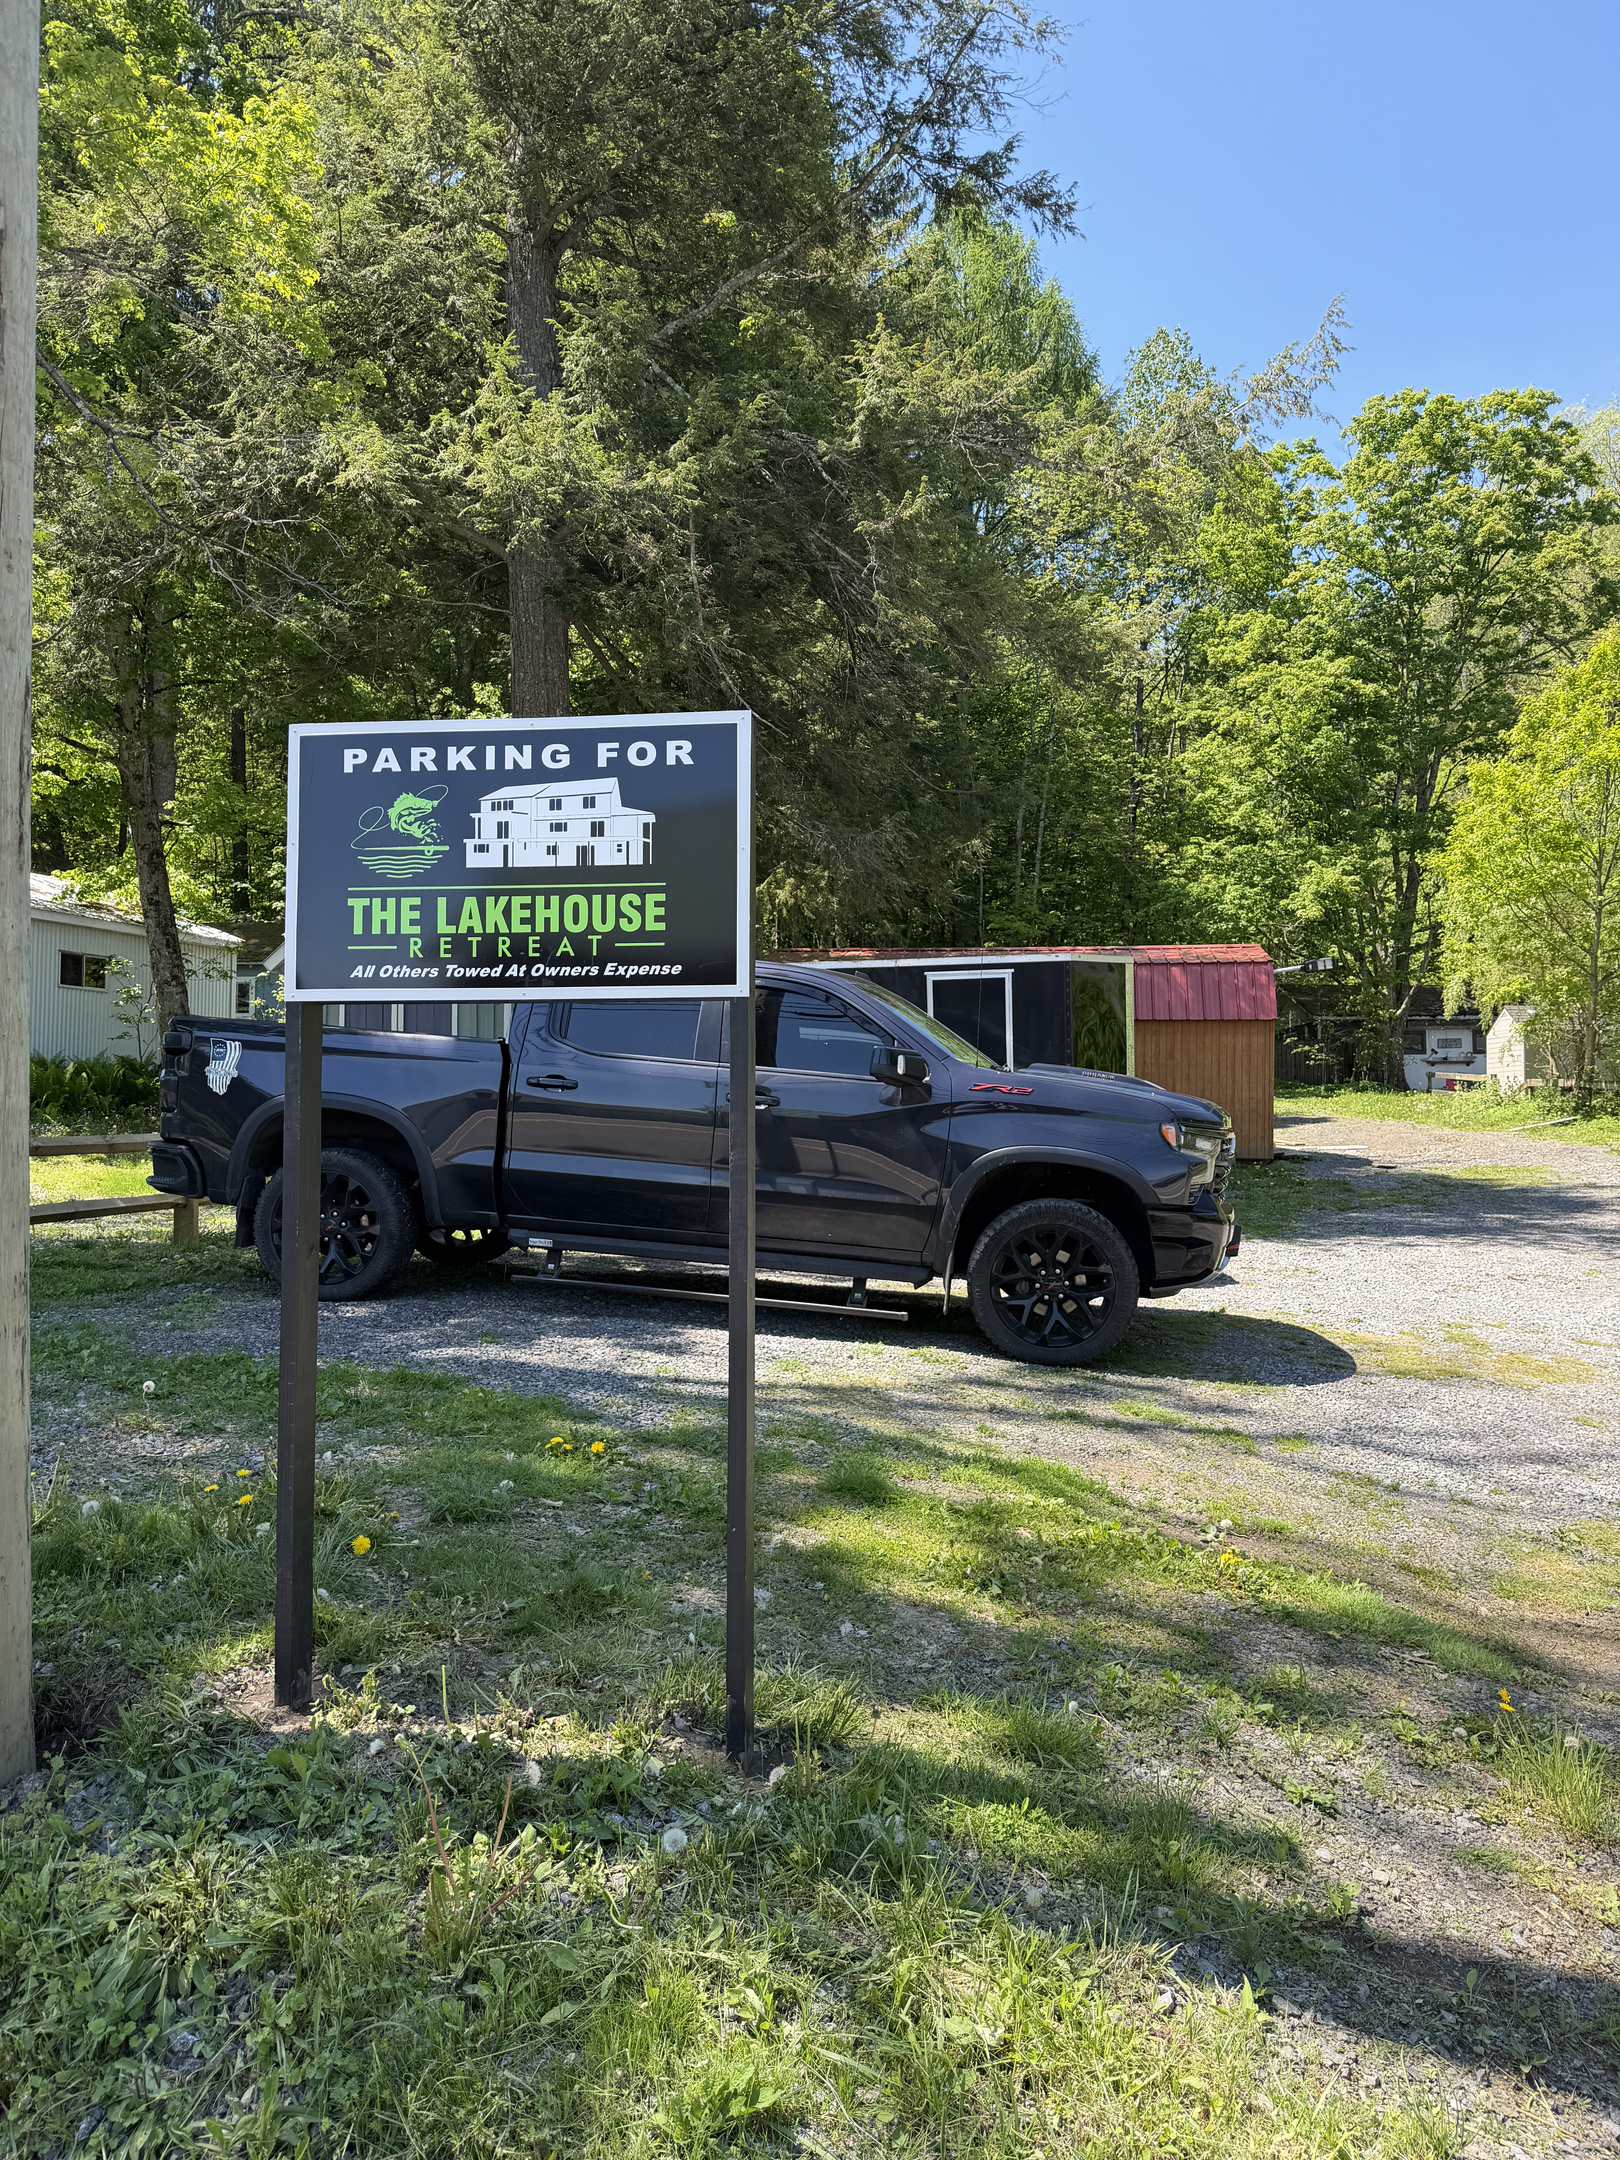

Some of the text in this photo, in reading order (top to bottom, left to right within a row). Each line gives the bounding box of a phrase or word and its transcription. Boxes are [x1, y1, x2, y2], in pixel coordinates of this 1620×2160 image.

[343, 739, 695, 774] PARKING FOR
[346, 892, 667, 936] THE LAKEHOUSE
[408, 934, 603, 959] RETREAT
[349, 962, 683, 979] All Others Towed At Owners Expense
